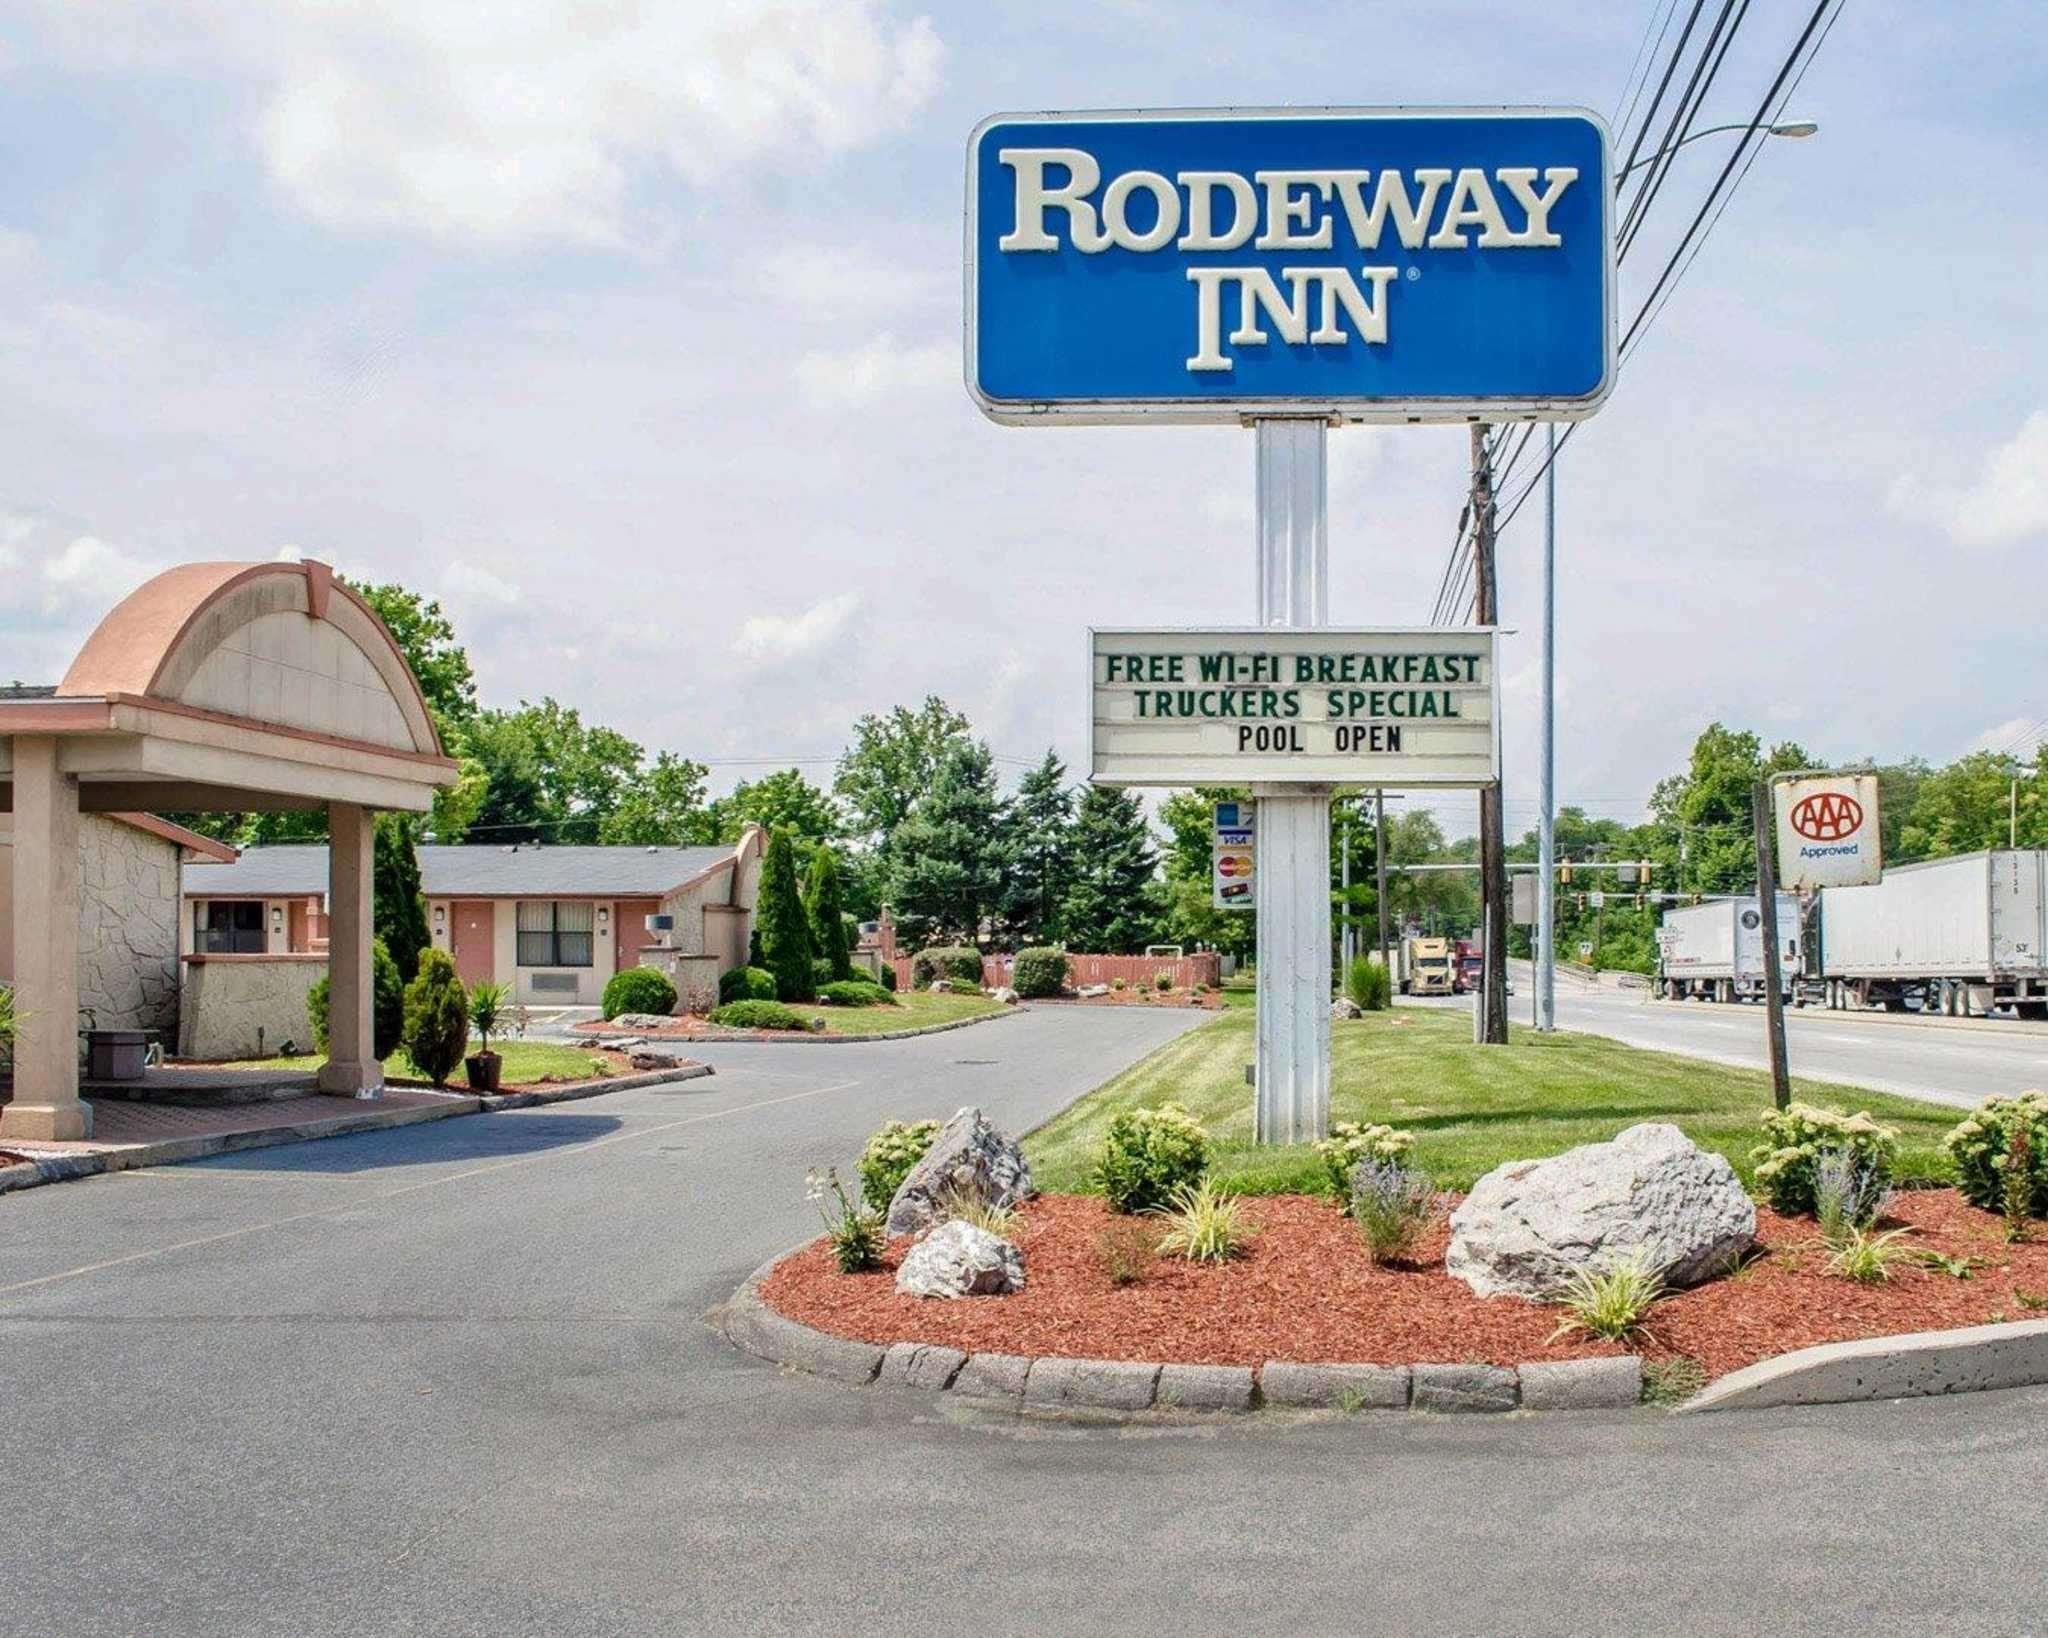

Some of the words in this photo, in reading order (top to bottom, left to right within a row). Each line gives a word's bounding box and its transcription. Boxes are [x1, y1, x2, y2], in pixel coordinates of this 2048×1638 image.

[1000, 148, 1578, 253] RODEWAY
[1187, 266, 1398, 371] INN
[1107, 655, 1184, 683] FREE
[1200, 655, 1279, 683] WI-FI
[1296, 655, 1480, 683] BREAKFAST
[1134, 690, 1300, 718] TRUCKERS
[1327, 690, 1460, 718] SPECIAL
[1238, 725, 1304, 752] POOL
[1335, 725, 1402, 752] OPEN
[1799, 793, 1859, 840] AAA
[1223, 835, 1247, 844] VISA
[1800, 844, 1858, 858] Approved
